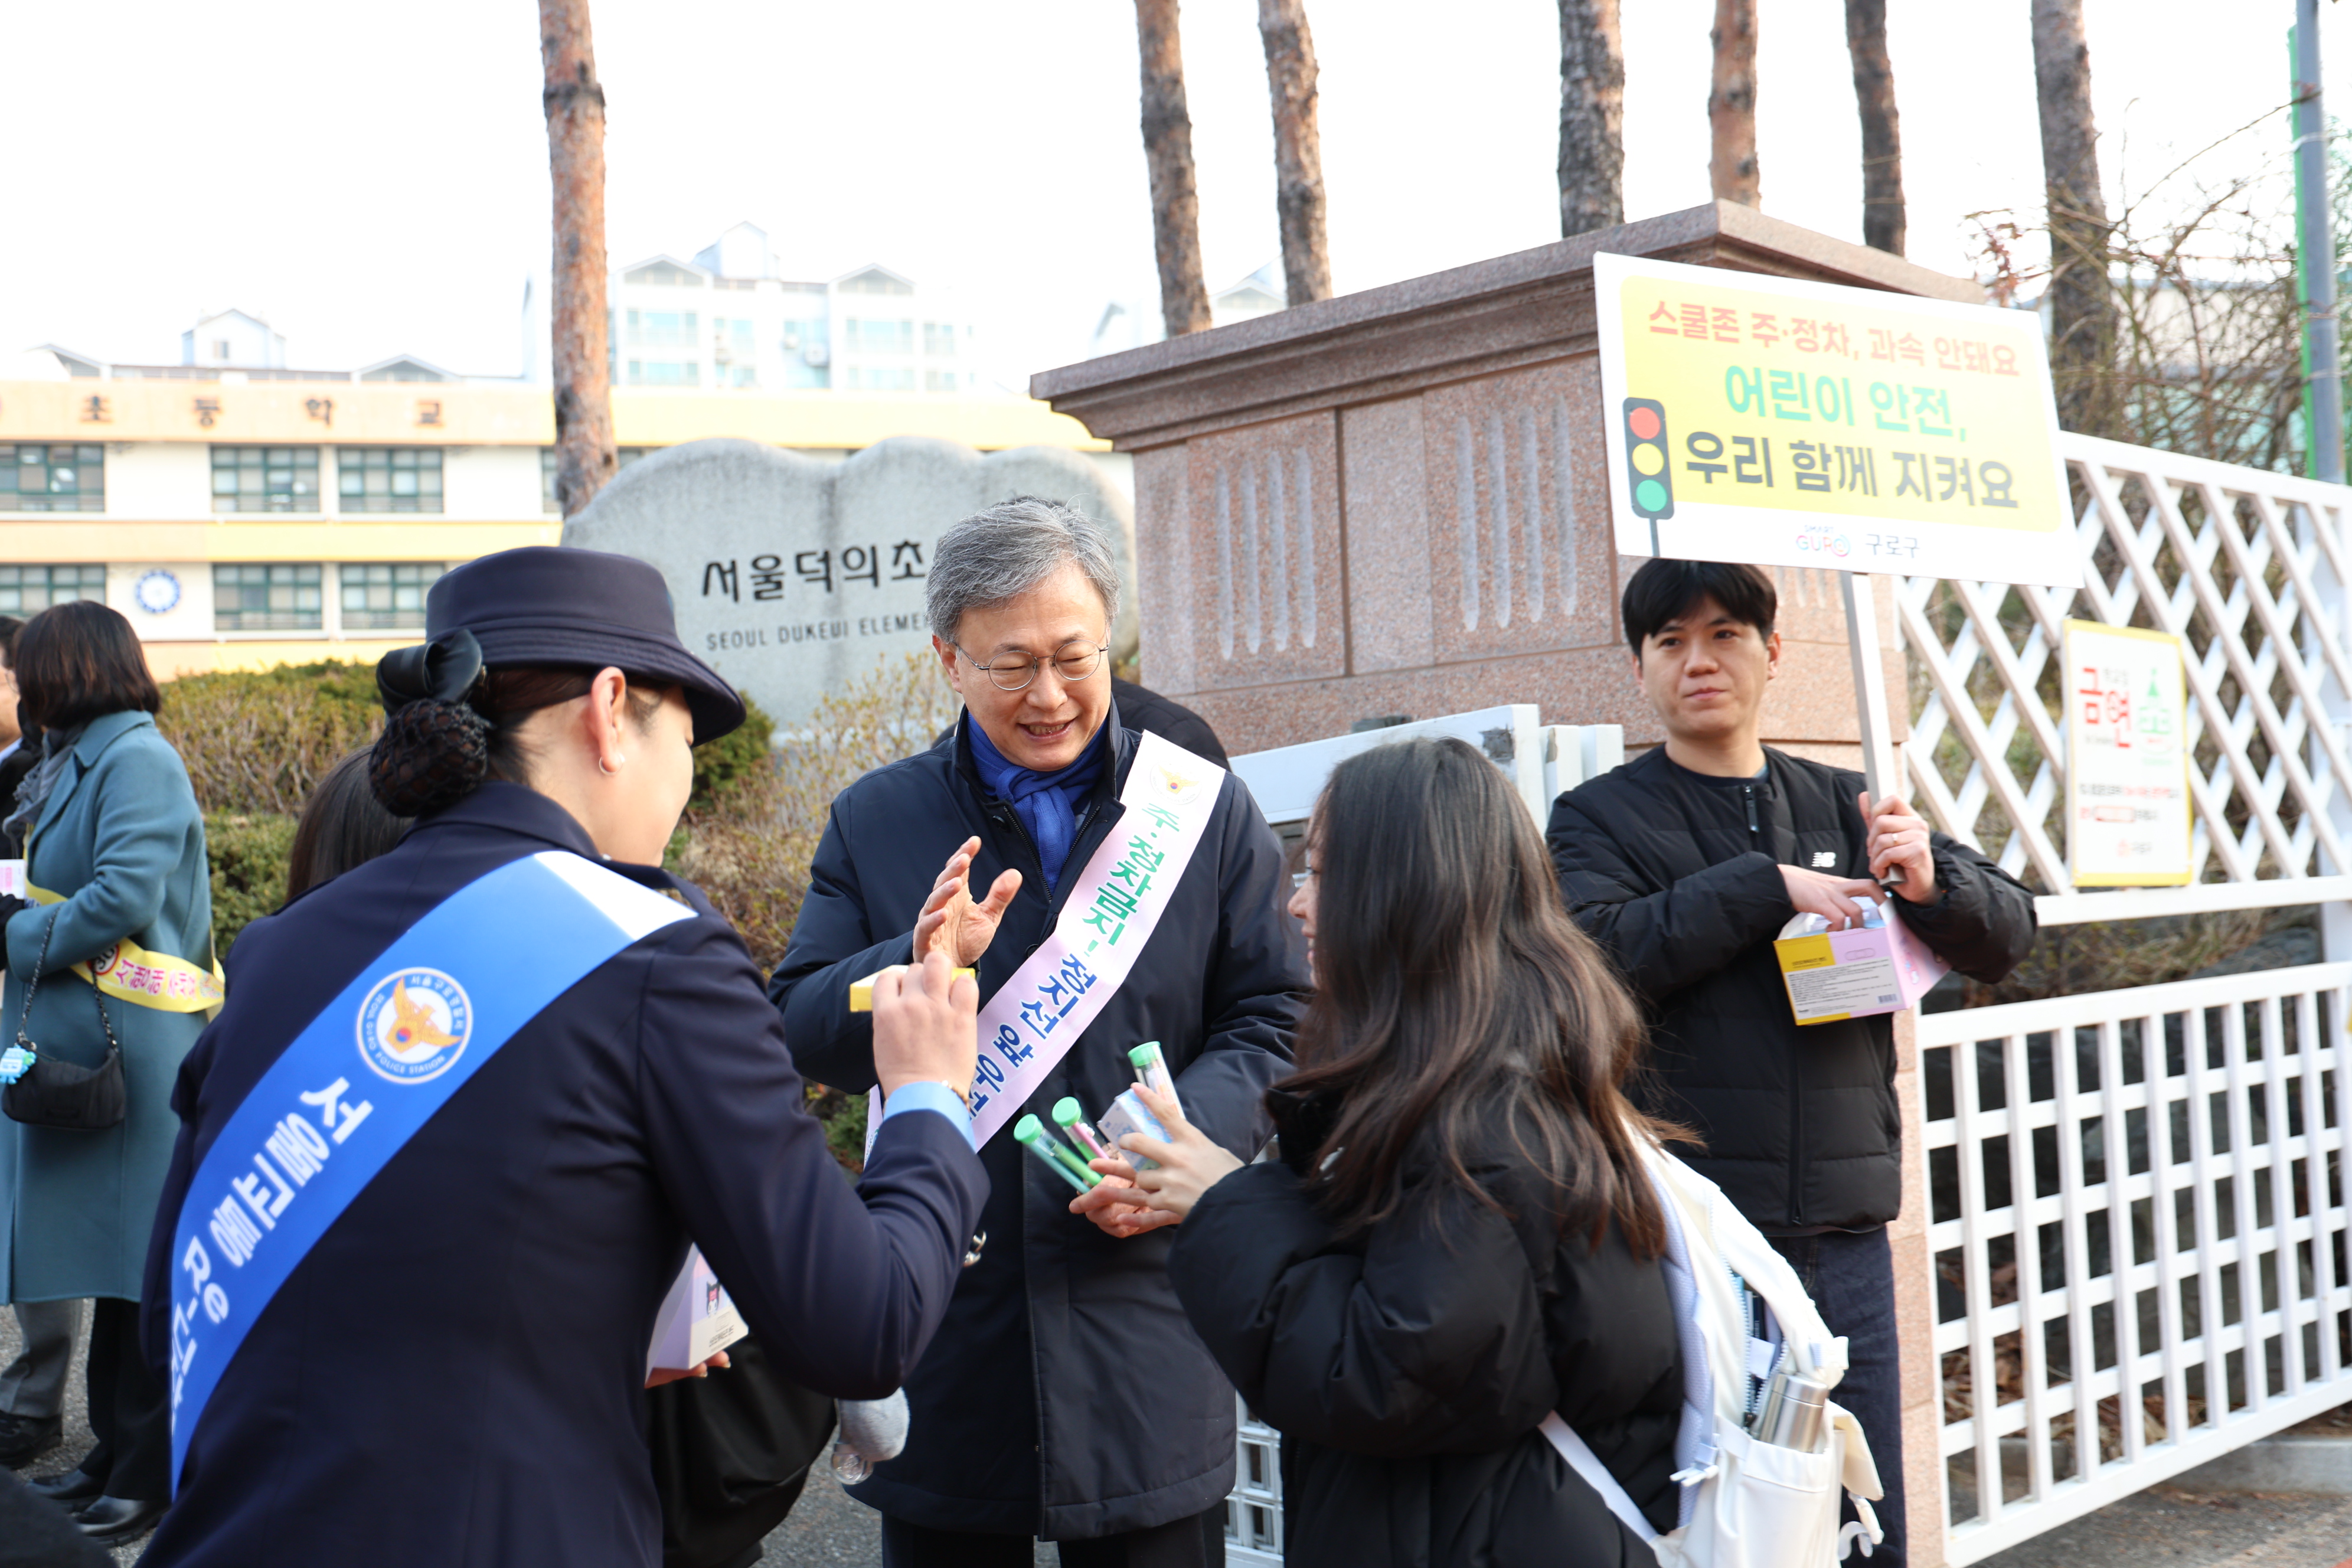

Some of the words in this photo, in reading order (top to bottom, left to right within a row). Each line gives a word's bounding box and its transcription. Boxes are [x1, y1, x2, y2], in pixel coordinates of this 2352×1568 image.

[1649, 300, 1740, 344] 스쿨존
[1751, 312, 1859, 361] 주·정차,
[1868, 328, 1925, 366] 과속
[1934, 337, 2020, 377] 안돼요
[1725, 365, 1854, 426] 어린이
[1870, 381, 1967, 442] 안전,
[1686, 431, 1773, 488] 우리
[1789, 439, 1878, 497] 함께
[1892, 451, 2018, 508] 지켜요
[1796, 534, 1851, 557] GURO
[1866, 534, 1921, 558] 구로구
[707, 629, 767, 651] SEOUL
[779, 620, 849, 644] DUKEUI
[2079, 667, 2132, 749] 금연
[115, 959, 165, 995] 서행해
[1020, 952, 1097, 1040] 정지선
[367, 992, 385, 1020] SEOUL
[411, 975, 465, 1030] 서울구로경찰서
[366, 1021, 377, 1051] GURO
[994, 1022, 1035, 1069] 앞
[375, 1050, 406, 1074] POLICE
[409, 1054, 446, 1075] STATION
[209, 1076, 373, 1269] 서울교통
